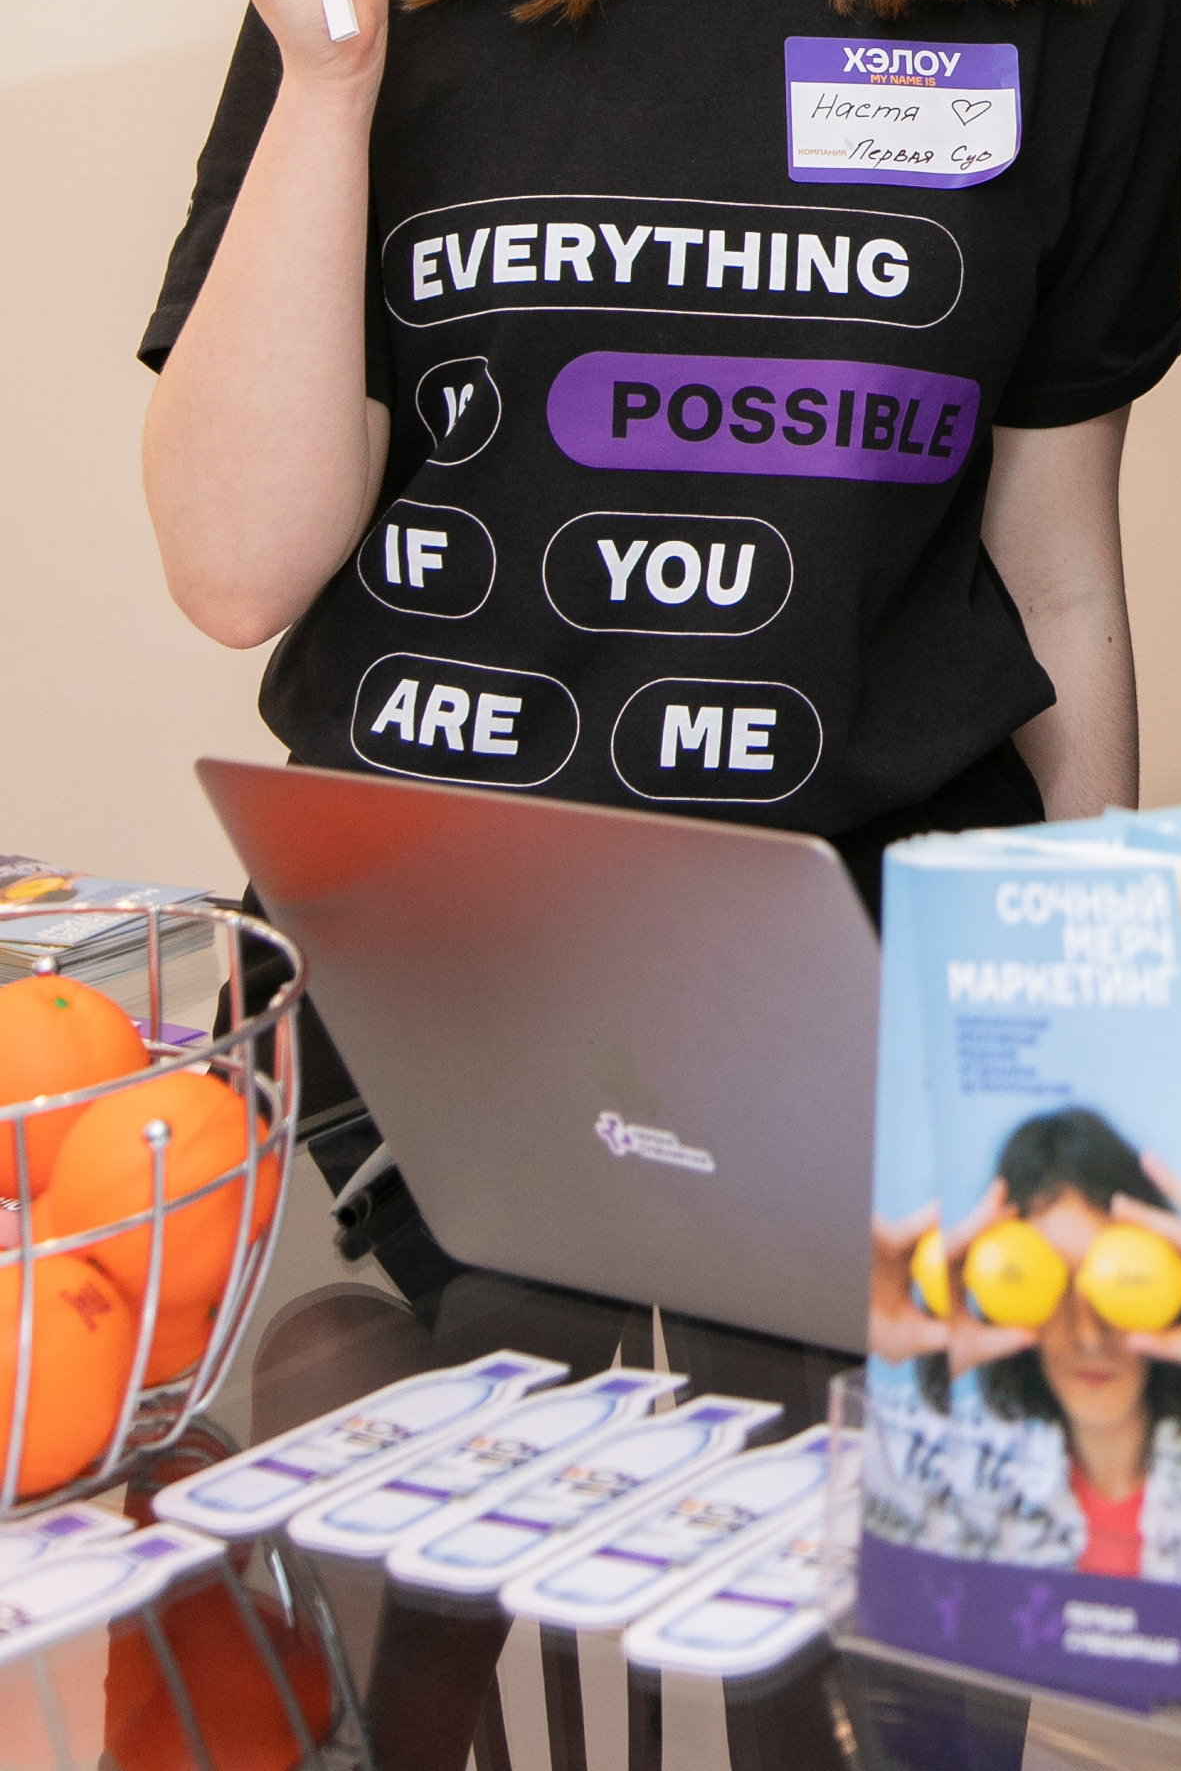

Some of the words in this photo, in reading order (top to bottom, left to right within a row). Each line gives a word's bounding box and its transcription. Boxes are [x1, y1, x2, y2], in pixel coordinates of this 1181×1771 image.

[843, 47, 961, 77] ХЭЛОУ
[870, 74, 888, 85] MY
[890, 75, 923, 86] NAME
[925, 76, 936, 87] IS
[811, 93, 920, 122] Настя
[798, 148, 847, 157] КОМПАНИЯ
[849, 139, 934, 169] Первая
[411, 222, 910, 301] EVERYTHING
[610, 380, 961, 459] POSSIBLE
[384, 524, 448, 588] IF
[597, 539, 756, 606] YOU
[370, 679, 523, 756] ARE
[660, 705, 777, 771] ME
